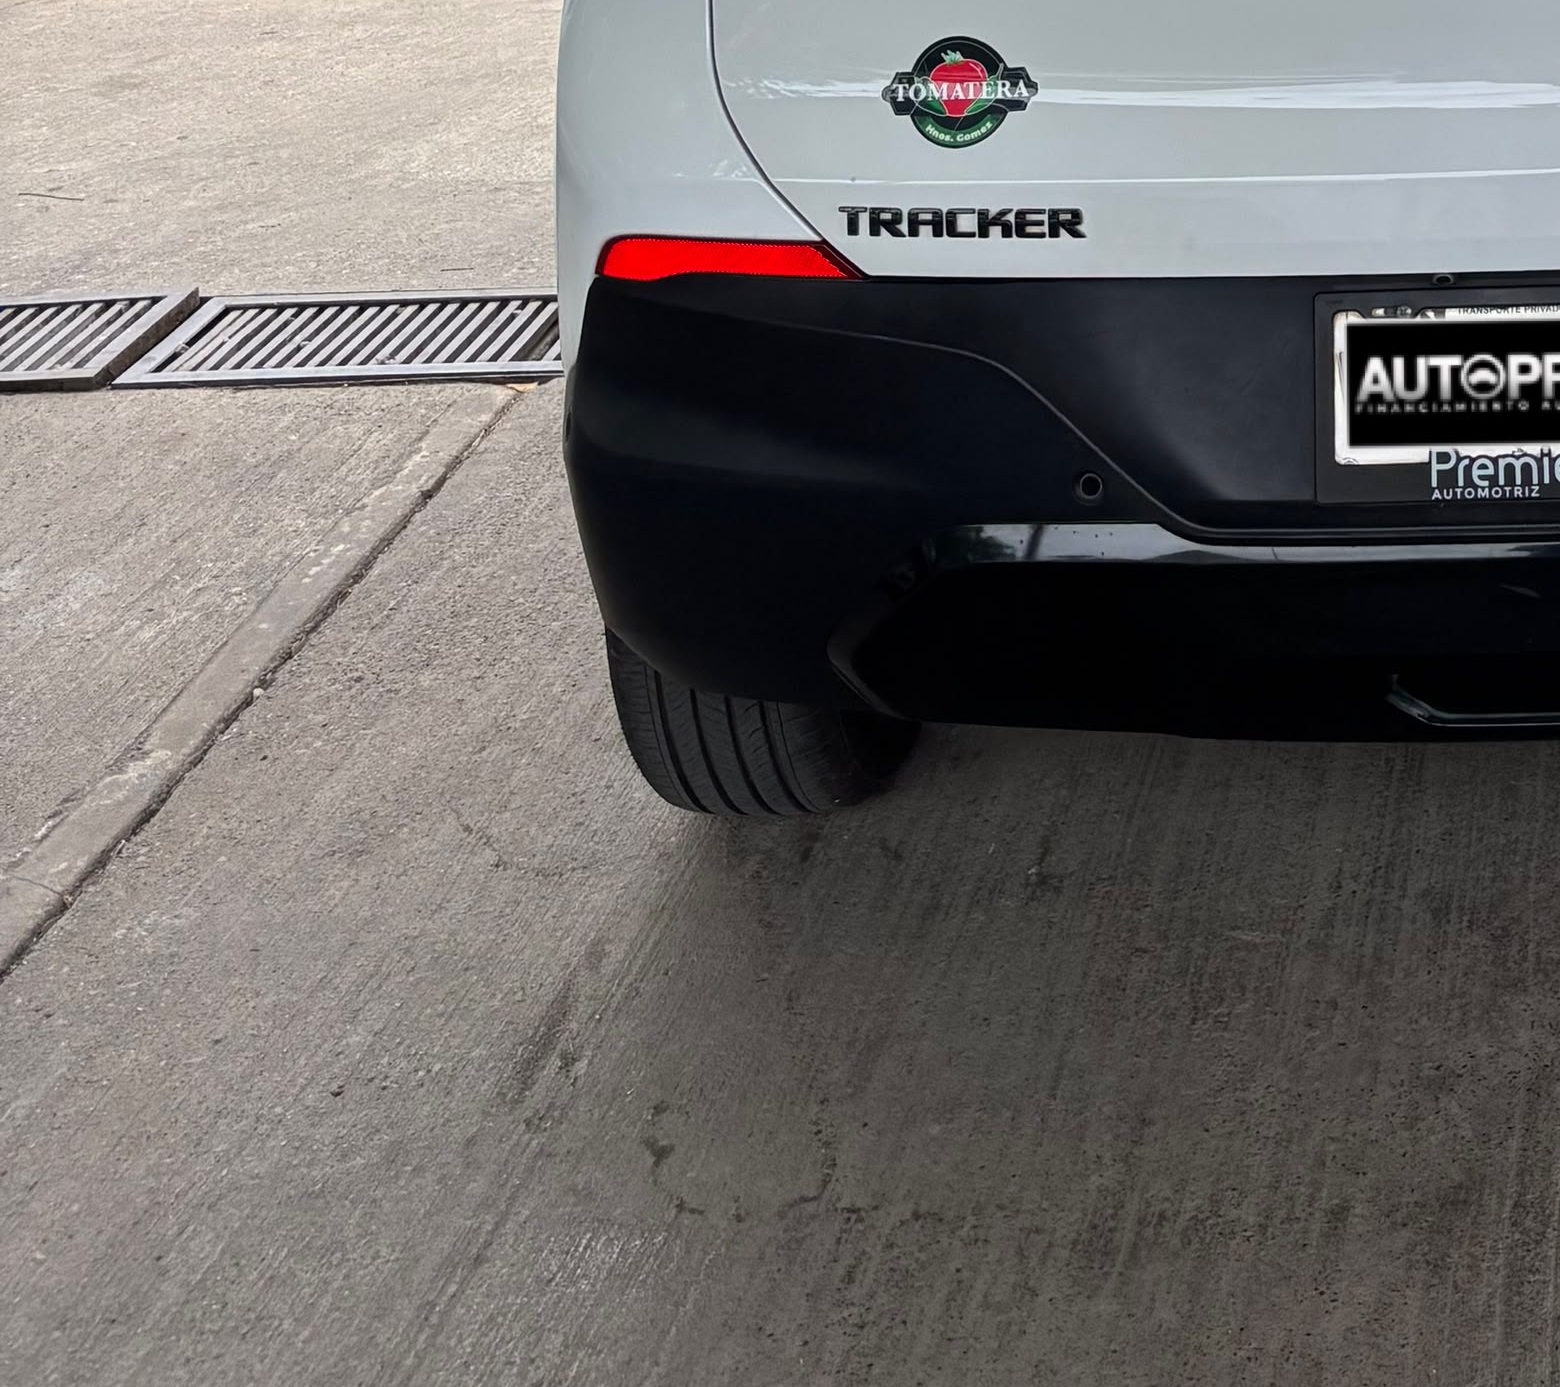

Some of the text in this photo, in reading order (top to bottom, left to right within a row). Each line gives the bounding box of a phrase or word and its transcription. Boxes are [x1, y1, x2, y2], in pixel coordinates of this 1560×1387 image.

[893, 79, 1030, 102] TOMATERA
[925, 121, 994, 142] Hnos. Gomez
[838, 206, 1087, 239] TRACKER
[1431, 486, 1541, 500] AUTOMOTRIZ
